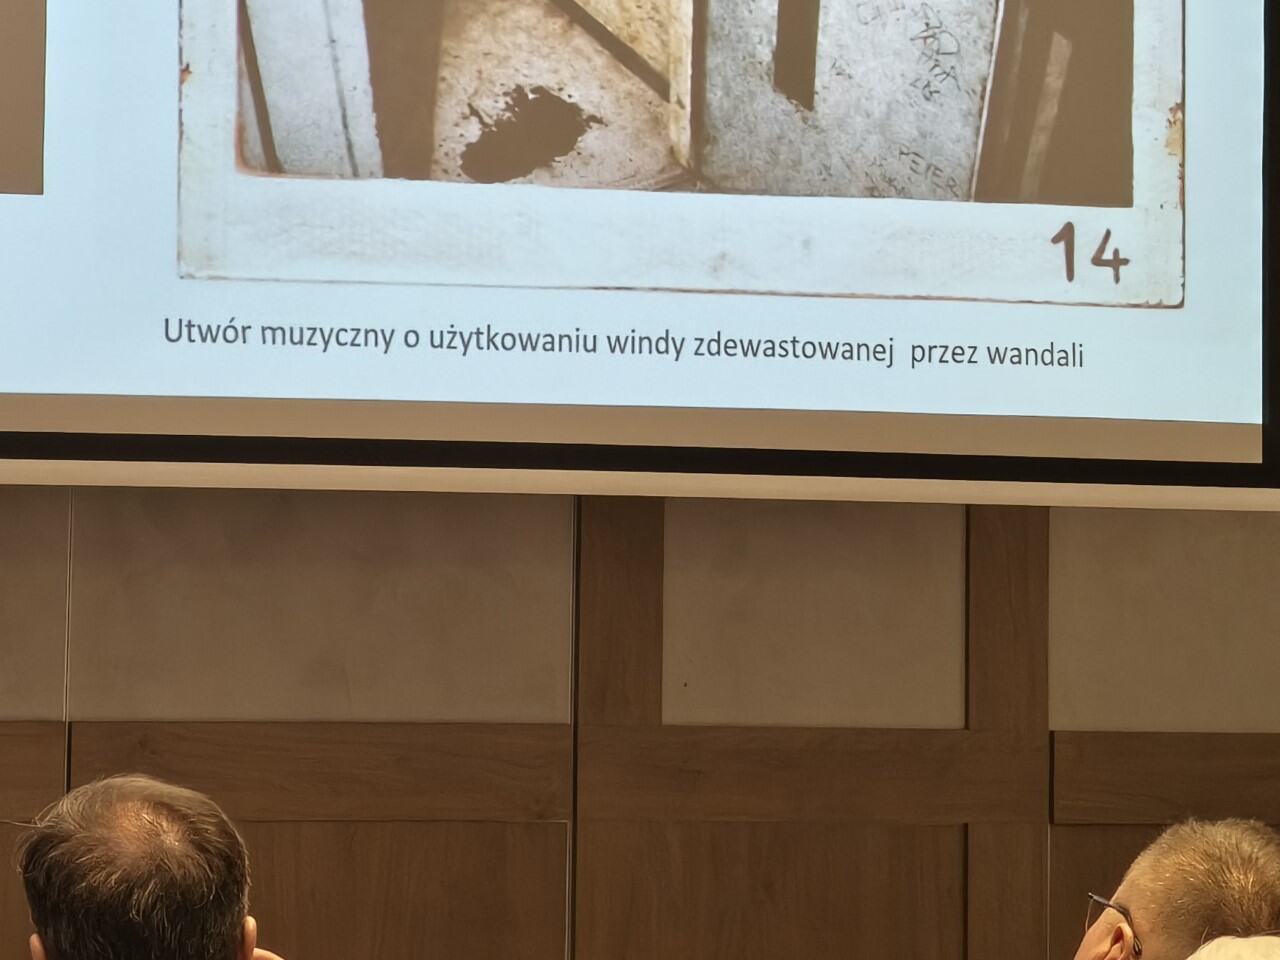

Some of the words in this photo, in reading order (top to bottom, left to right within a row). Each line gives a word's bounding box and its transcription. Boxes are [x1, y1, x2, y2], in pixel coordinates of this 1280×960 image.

[1050, 221, 1131, 284] 14
[163, 317, 252, 345] Utwór
[260, 324, 396, 353] muzyczny
[404, 331, 420, 348] o
[428, 324, 598, 357] użytkowaniu
[606, 329, 686, 361] windy
[693, 332, 895, 368] zdewastowanej
[910, 344, 978, 367] przez
[986, 341, 1086, 368] wandali
